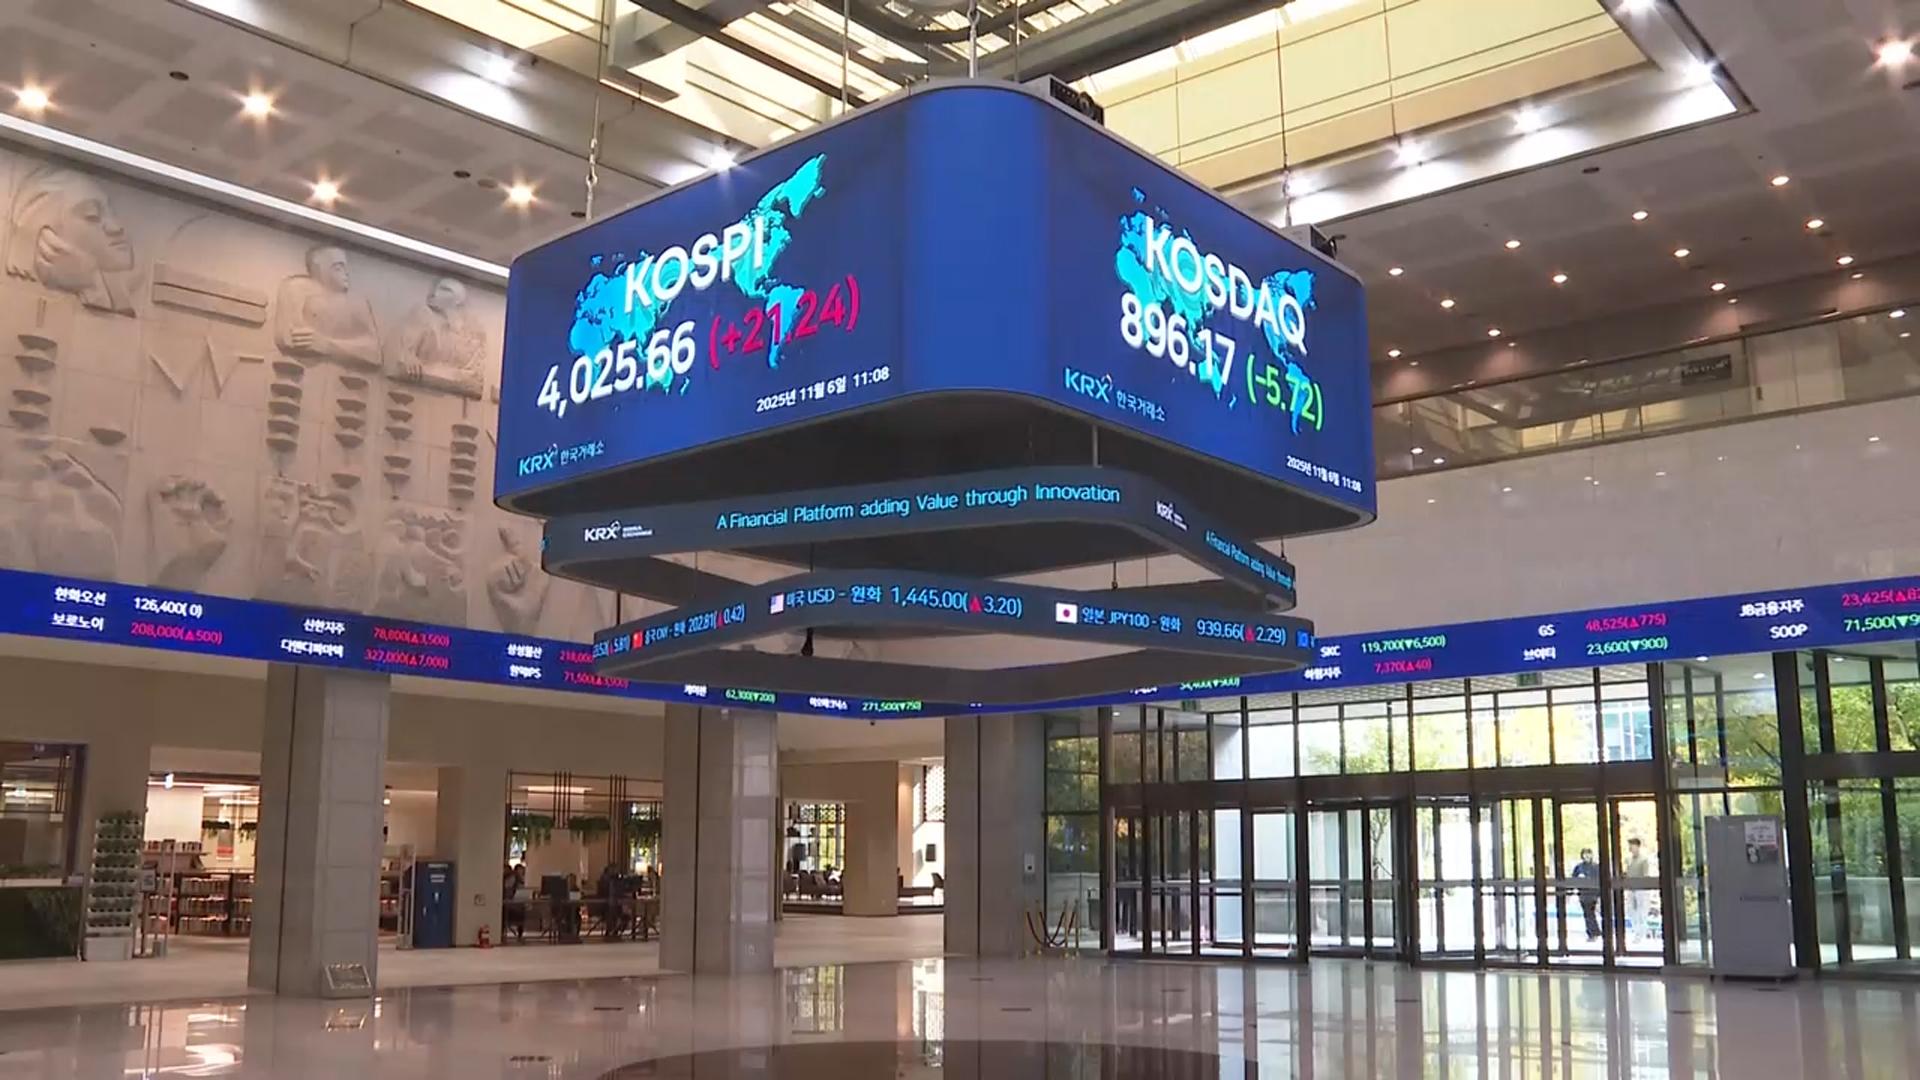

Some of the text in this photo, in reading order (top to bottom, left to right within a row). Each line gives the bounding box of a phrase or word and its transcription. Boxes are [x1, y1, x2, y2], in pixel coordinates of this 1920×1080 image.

[623, 217, 764, 313] KOSPI
[1144, 215, 1308, 355] KOSDAQ
[537, 274, 861, 418] 4,025.66 (+21.24)
[1120, 292, 1325, 431] 896.17 (-5.72)
[756, 366, 890, 413] 2025년 11월 6일 11:08
[1065, 367, 1167, 422] KRX 한국거래소
[519, 440, 605, 476] KRX 한국거래소
[716, 484, 1121, 530] A Financial Platform adding Value through Innovation
[584, 521, 620, 542] KRX
[55, 586, 107, 607] 한화오션
[785, 591, 805, 608] 미국
[806, 588, 835, 604] USD
[851, 585, 881, 606] 원화
[1739, 599, 1804, 617] JB금융지주
[51, 612, 104, 632] 보로노이
[303, 618, 345, 635] 신한지주
[1081, 606, 1106, 625] 일본
[1107, 612, 1150, 629] JPY100
[1159, 615, 1182, 633] 원화
[1538, 624, 1556, 637] GS
[1769, 623, 1809, 640] SOOP
[1320, 645, 1342, 658] SKC
[1523, 645, 1557, 661] 브이티
